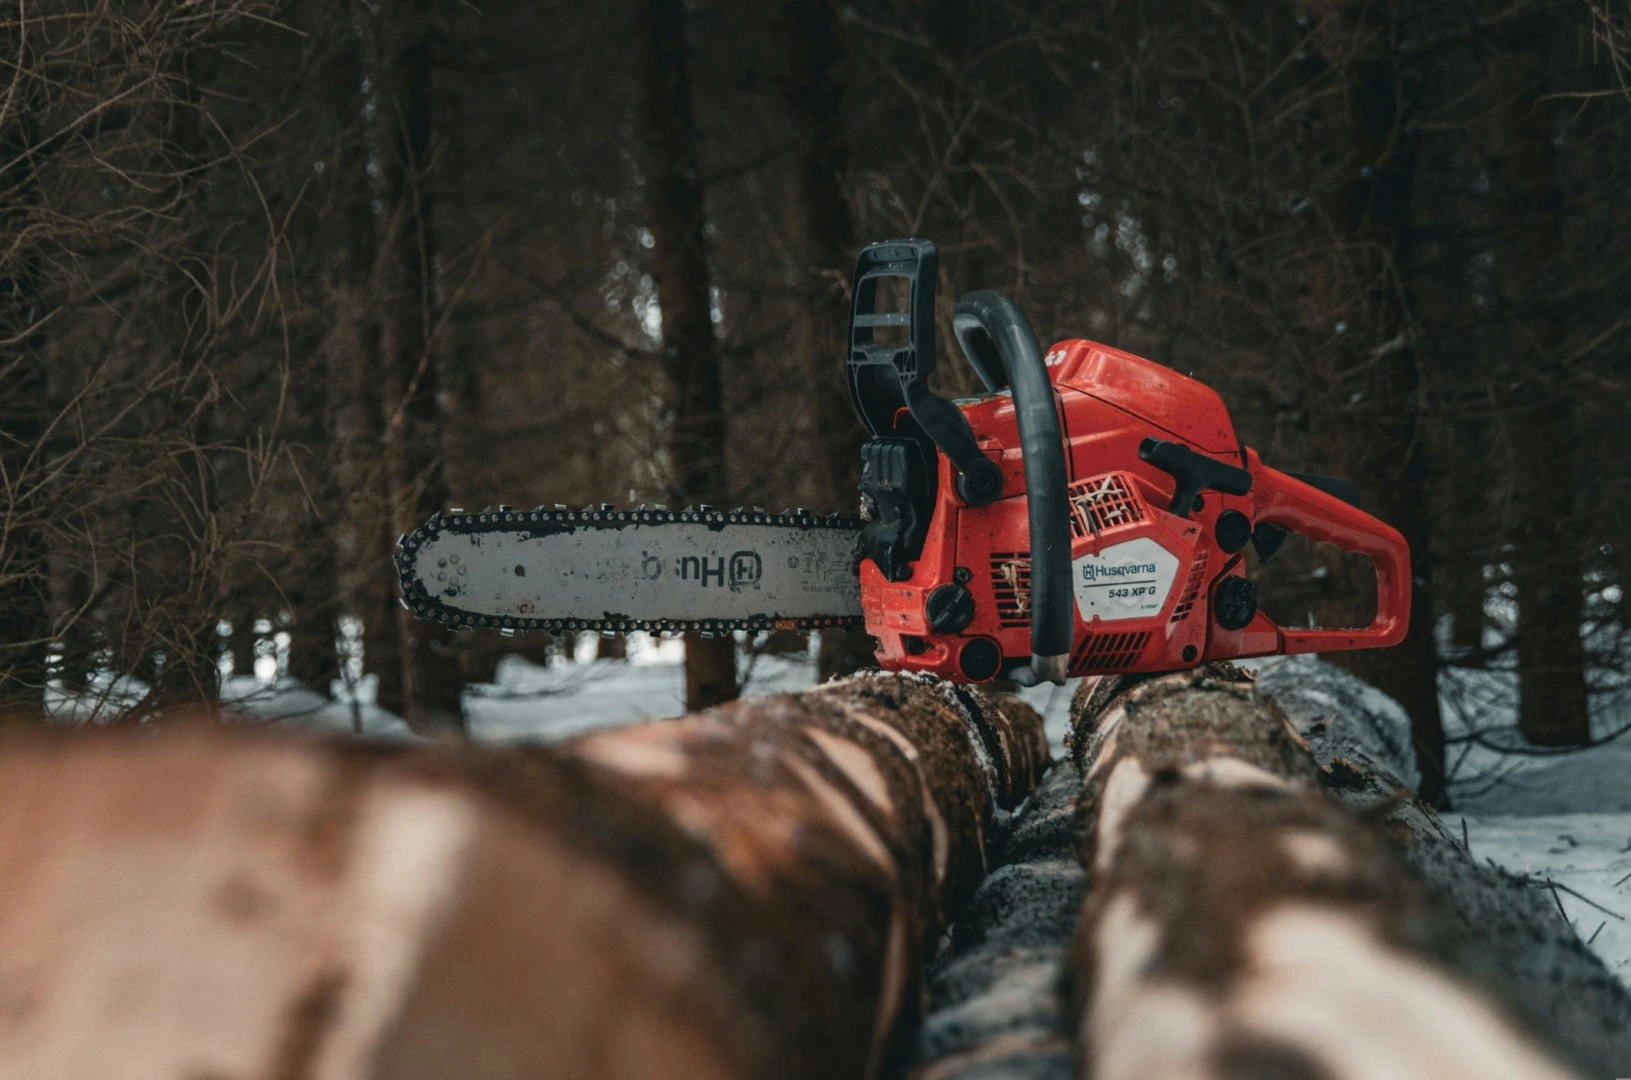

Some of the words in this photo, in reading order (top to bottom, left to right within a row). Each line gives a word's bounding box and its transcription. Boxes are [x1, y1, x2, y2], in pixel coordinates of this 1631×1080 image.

[1096, 563, 1156, 577] Husqvarna
[1109, 588, 1129, 598] 543
[1148, 586, 1156, 595] G
